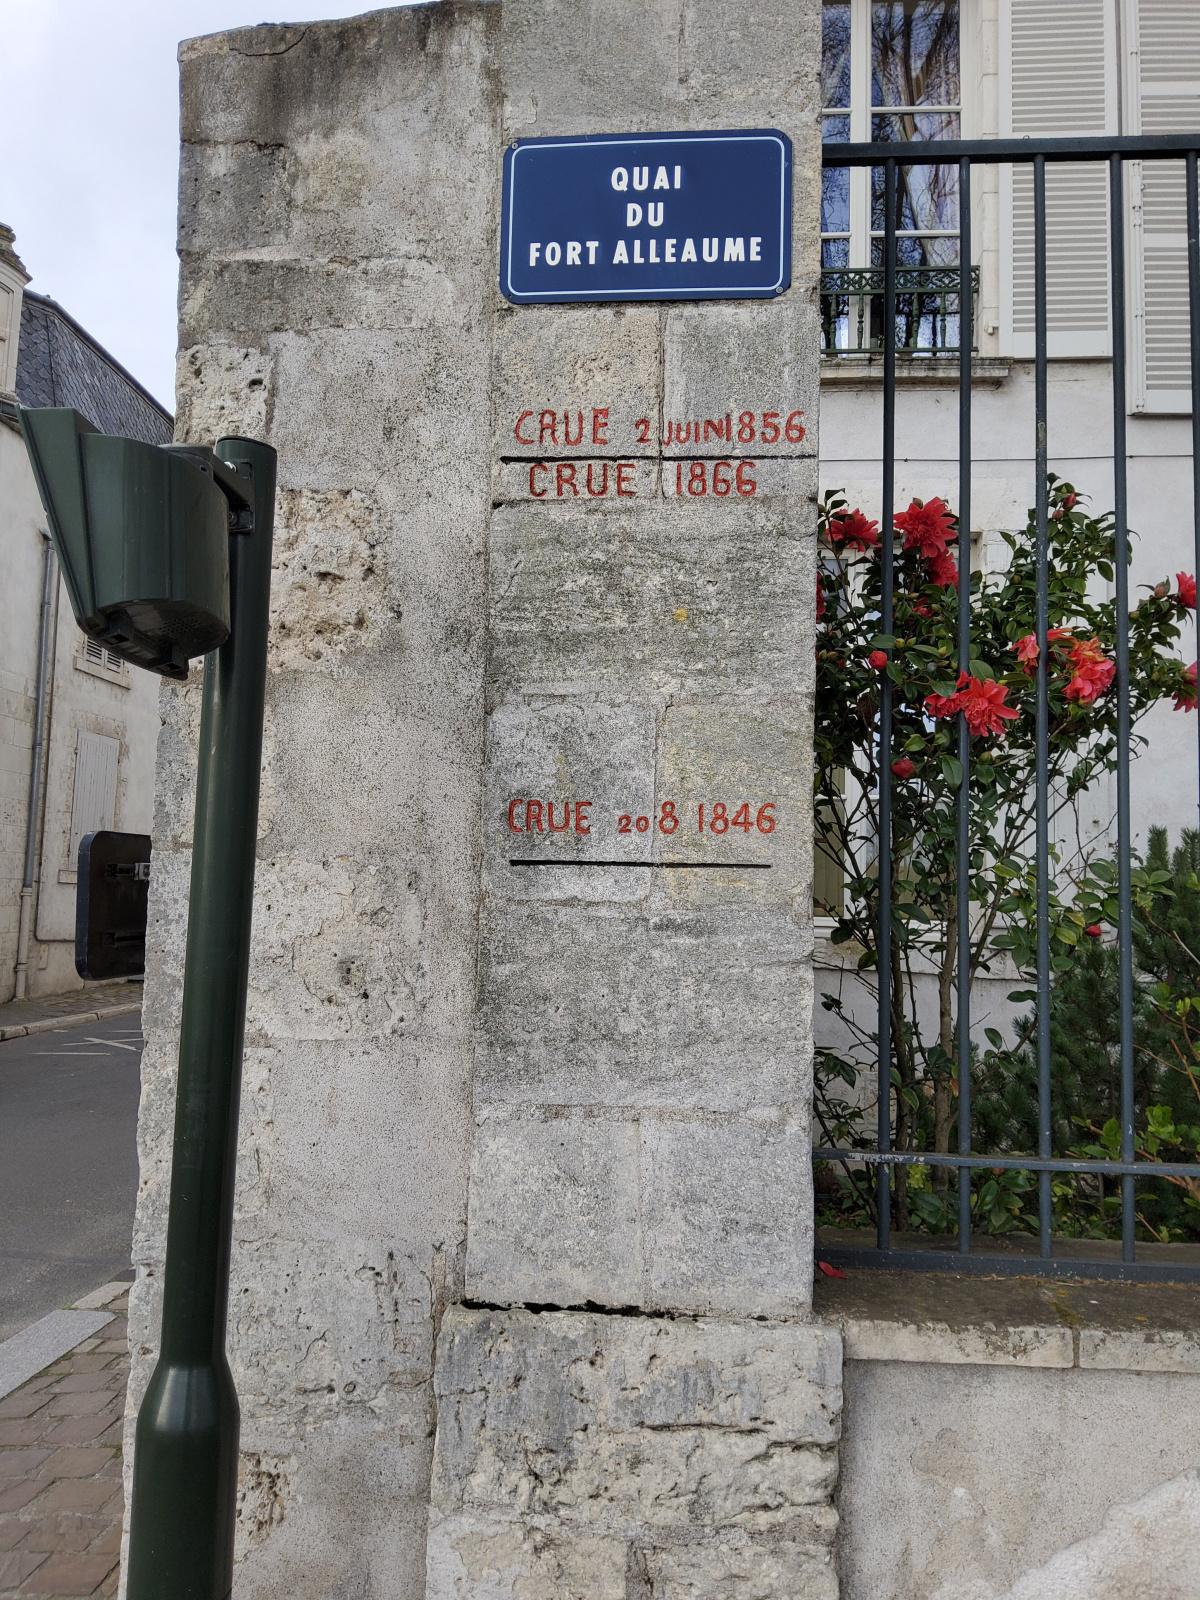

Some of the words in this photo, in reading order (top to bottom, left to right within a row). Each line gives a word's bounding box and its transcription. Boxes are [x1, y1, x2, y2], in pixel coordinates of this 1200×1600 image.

[611, 165, 682, 191] QUAI
[626, 202, 664, 227] DU
[529, 241, 600, 267] FORT
[612, 237, 762, 264] ALLEAUME
[514, 407, 609, 446] CRUE
[635, 418, 651, 443] 2
[529, 463, 637, 497] CRUE
[676, 461, 757, 496] 1866
[508, 799, 593, 835] CRUE
[697, 802, 777, 835] 1846
